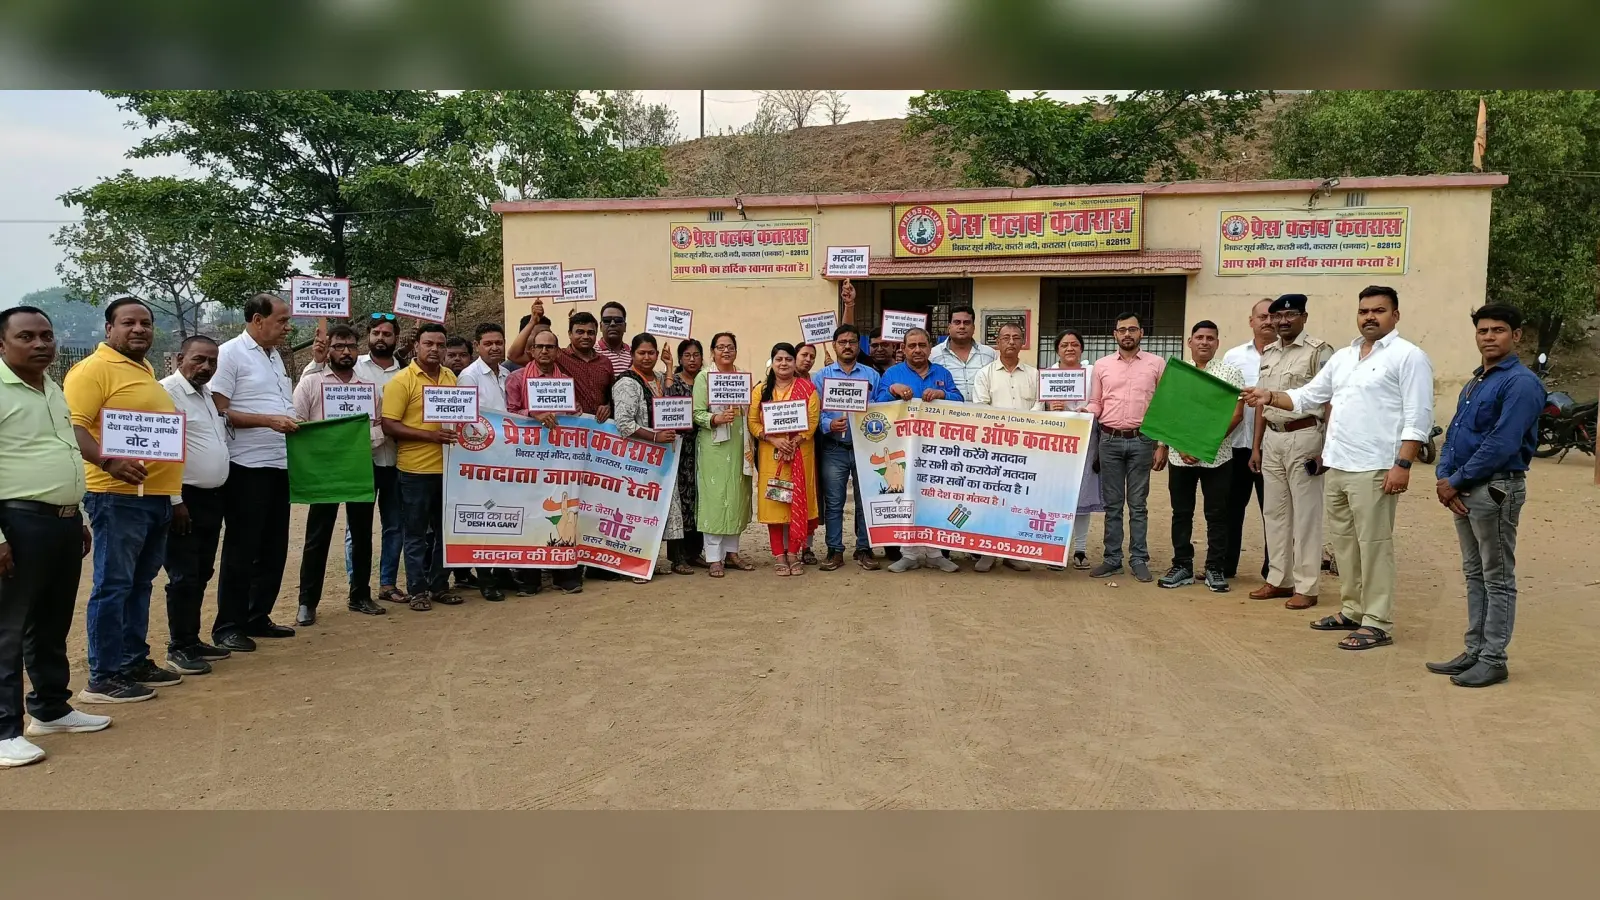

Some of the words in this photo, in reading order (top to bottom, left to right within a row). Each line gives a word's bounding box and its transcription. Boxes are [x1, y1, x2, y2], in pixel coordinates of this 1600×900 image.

[900, 207, 922, 228] PRESS
[924, 208, 942, 227] CLUB
[946, 208, 986, 240] प्रेस
[988, 212, 1047, 237] क्लब
[1049, 207, 1135, 235] कतरास
[1250, 216, 1283, 240] प्रेस
[1285, 219, 1333, 238] क्लब
[1334, 218, 1404, 237] कतरास
[693, 227, 717, 248] प्रेस
[719, 229, 755, 247] क्लब
[757, 228, 809, 246] कतरास
[1106, 238, 1131, 246] 828113
[905, 242, 937, 254] KATRAS
[832, 254, 864, 262] मतदान
[1222, 259, 1243, 268] आप
[1246, 257, 1267, 268] सभी
[1269, 259, 1283, 268] का
[1286, 256, 1317, 268] हार्दिक
[1321, 258, 1354, 267] स्वागत
[1356, 258, 1384, 267] करता
[674, 265, 690, 274] आप
[692, 263, 707, 274] सभी
[709, 265, 720, 274] का
[722, 262, 746, 273] हार्दिक
[749, 264, 774, 273] स्वागत
[775, 263, 797, 272] करता
[299, 287, 341, 295] मतदान
[422, 293, 440, 304] वोट
[668, 315, 683, 324] वोट
[829, 387, 862, 396] मतदान
[536, 395, 566, 403] मतदान
[339, 401, 354, 411] वोट
[435, 405, 465, 413] मतदान
[118, 413, 133, 421] नशे
[134, 414, 142, 422] से
[156, 416, 170, 424] नोट
[949, 409, 970, 418] Region
[773, 417, 798, 425] मतदान
[107, 422, 120, 431] देश
[123, 424, 152, 433] बदलेगा
[872, 422, 880, 433] L
[125, 434, 149, 447] वोट
[152, 440, 160, 448] से
[502, 418, 542, 445] प्रेस
[591, 430, 667, 467] कतरास
[939, 421, 978, 442] क्लब
[981, 422, 1020, 447] ऑफ
[1022, 430, 1080, 454] कतरास
[462, 442, 486, 451] KATRAS
[922, 444, 937, 454] हम
[939, 444, 961, 457] सभी
[963, 447, 989, 460] करेंगे
[991, 452, 1027, 465] मतदान
[928, 459, 949, 471] सभी
[950, 461, 964, 472] को
[1002, 469, 1037, 481] मतदान
[459, 463, 539, 484] मतदाता
[622, 476, 662, 501] रैली
[929, 474, 944, 484] हम
[946, 475, 966, 487] सबों
[967, 479, 980, 489] का
[1014, 483, 1022, 495] है
[921, 487, 935, 497] यही
[937, 489, 951, 500] देश
[952, 492, 964, 501] का
[991, 496, 999, 506] है
[595, 503, 614, 516] जैसा
[626, 513, 642, 524] कुछ
[874, 505, 896, 516] चुनाव
[1010, 505, 1022, 514] वोट
[458, 511, 485, 522] चुनाव
[487, 512, 502, 520] का
[504, 510, 521, 521] पर्व
[917, 528, 934, 540] की
[937, 531, 966, 546] तिथि
[978, 540, 1043, 556] 25.05.2024
[472, 549, 523, 561] मतदान
[526, 548, 547, 561] की
[629, 546, 642, 554] हम
